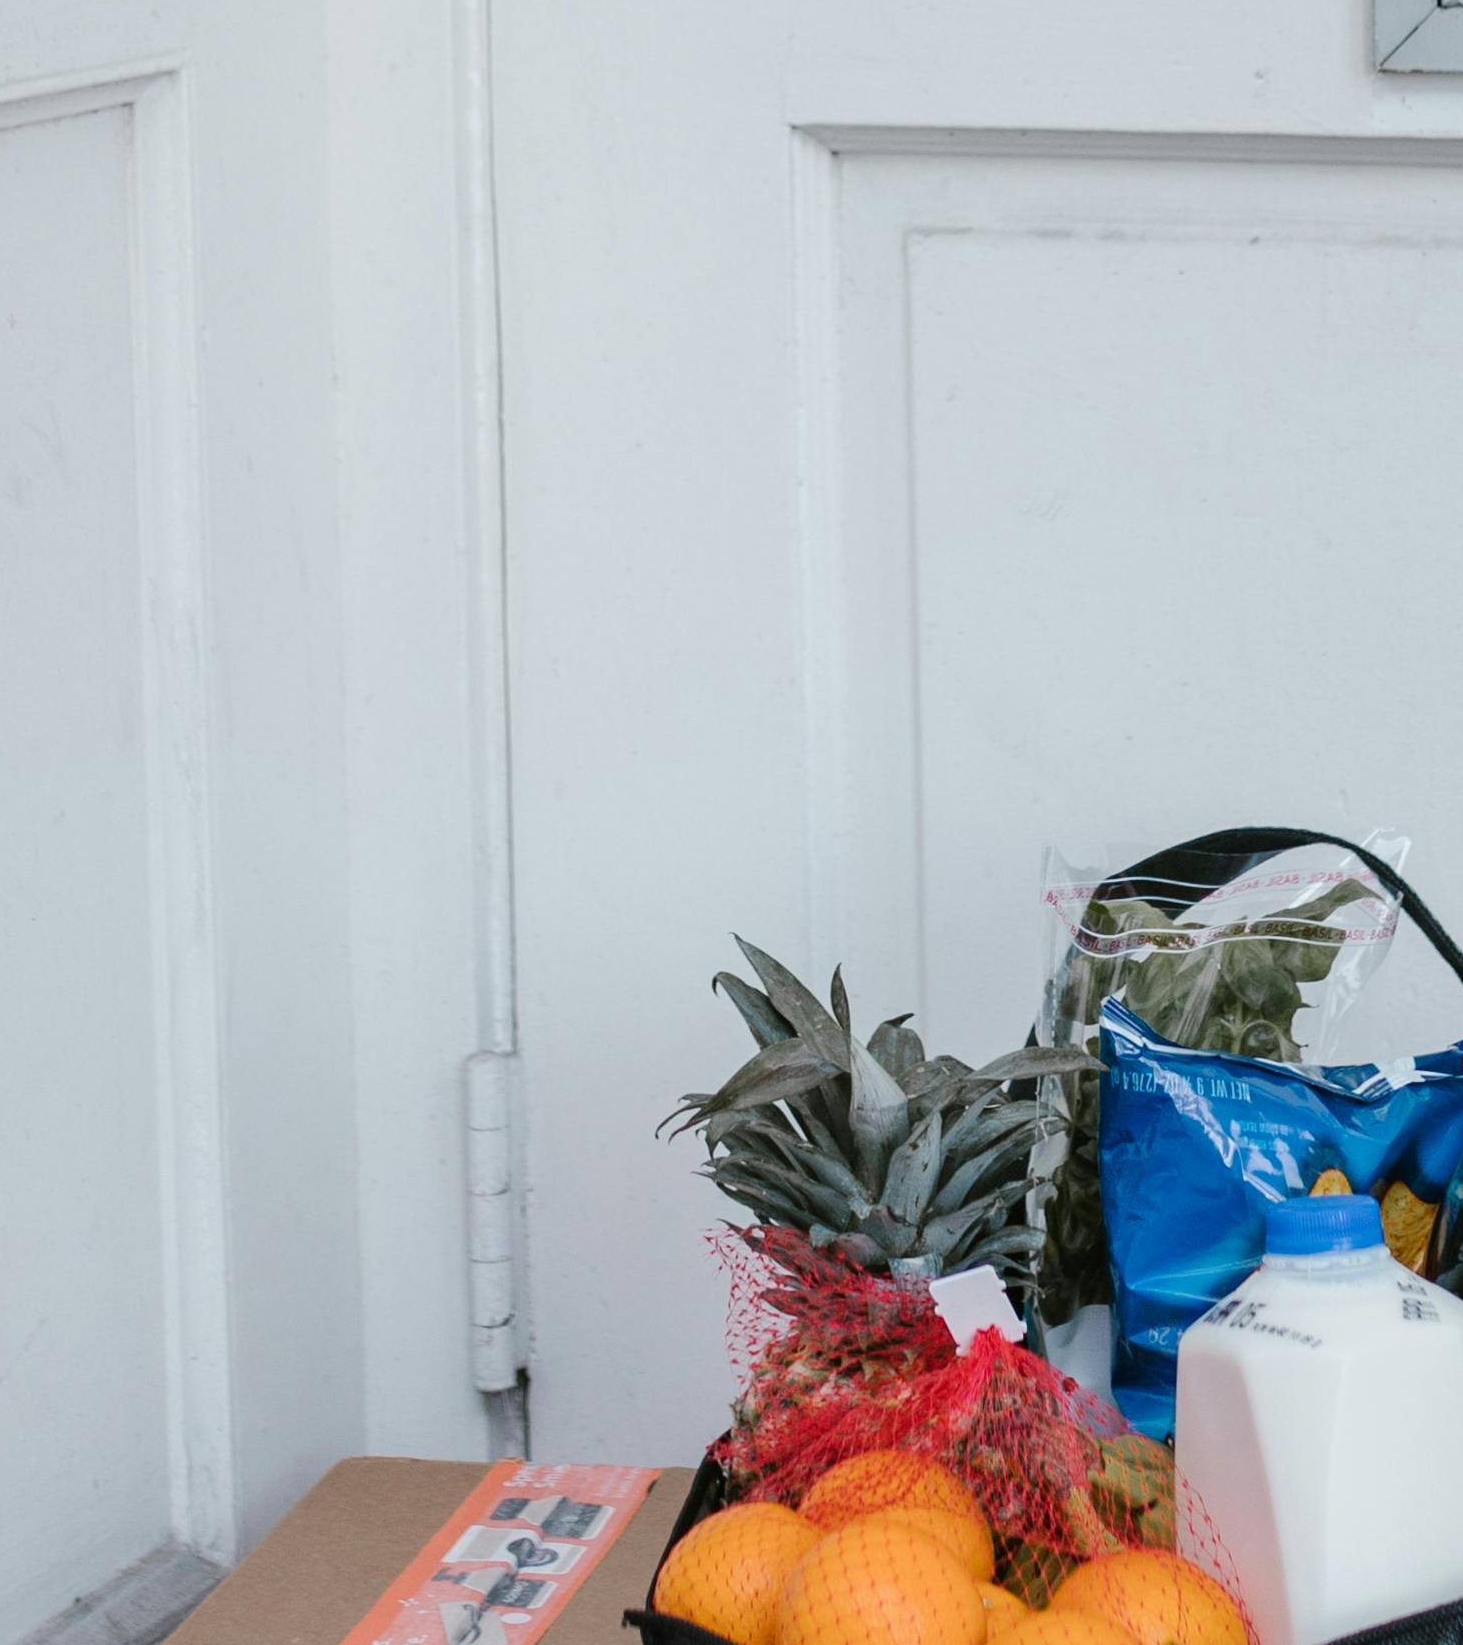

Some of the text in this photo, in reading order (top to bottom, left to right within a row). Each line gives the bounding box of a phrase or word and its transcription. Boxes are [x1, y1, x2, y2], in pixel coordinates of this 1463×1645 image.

[1137, 934, 1169, 948] BASIL
[1265, 922, 1294, 935] BASIL
[1303, 926, 1334, 940] BASIL
[1340, 929, 1365, 941] BASIL
[1230, 1081, 1251, 1104] NET
